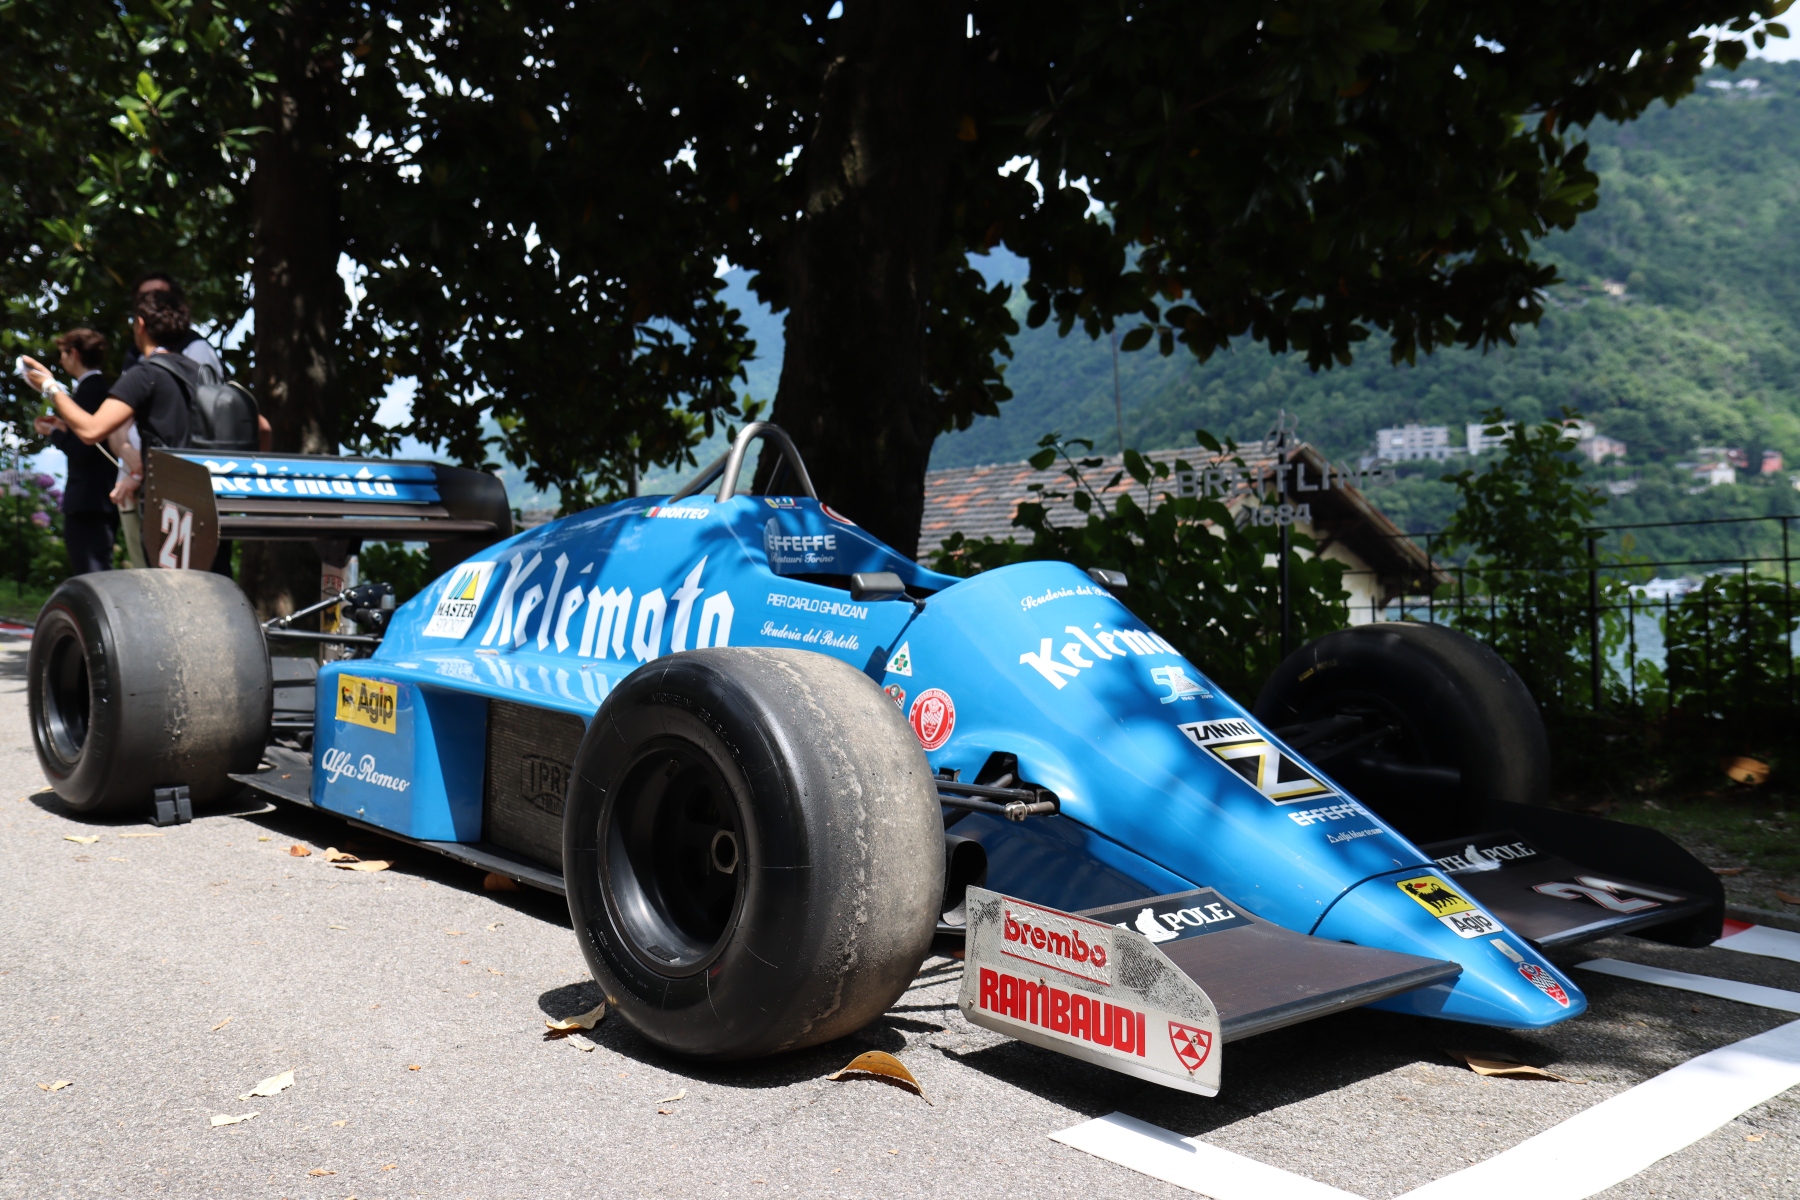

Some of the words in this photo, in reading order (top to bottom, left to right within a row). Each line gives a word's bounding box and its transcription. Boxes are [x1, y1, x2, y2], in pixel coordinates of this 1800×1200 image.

[1177, 457, 1396, 500] BREITLING
[657, 507, 710, 520] MORTEO
[1250, 503, 1312, 527] 1884
[159, 503, 193, 569] 21
[768, 534, 837, 551] EFFEFFE
[771, 553, 803, 564] Restauri
[804, 552, 835, 564] Torino
[435, 602, 477, 618] MASTER
[766, 593, 788, 607] PIER
[787, 597, 820, 613] CARLO
[820, 600, 868, 620] GHINZANI
[1021, 588, 1075, 611] Scuderia
[1076, 586, 1093, 596] del
[760, 621, 801, 641] Scuderia
[803, 629, 820, 645] del
[820, 630, 860, 651] Portello
[357, 682, 394, 725] Agip
[1186, 721, 1256, 742] ZANINI
[321, 748, 357, 784] Alfa
[357, 754, 411, 793] Romeo
[1479, 842, 1537, 863] POLE
[1531, 875, 1686, 914] 21
[1159, 902, 1237, 932] POLE
[1449, 912, 1494, 934] Agip
[1003, 910, 1108, 968] brembo
[979, 966, 1146, 1058] RAMBAUDI
